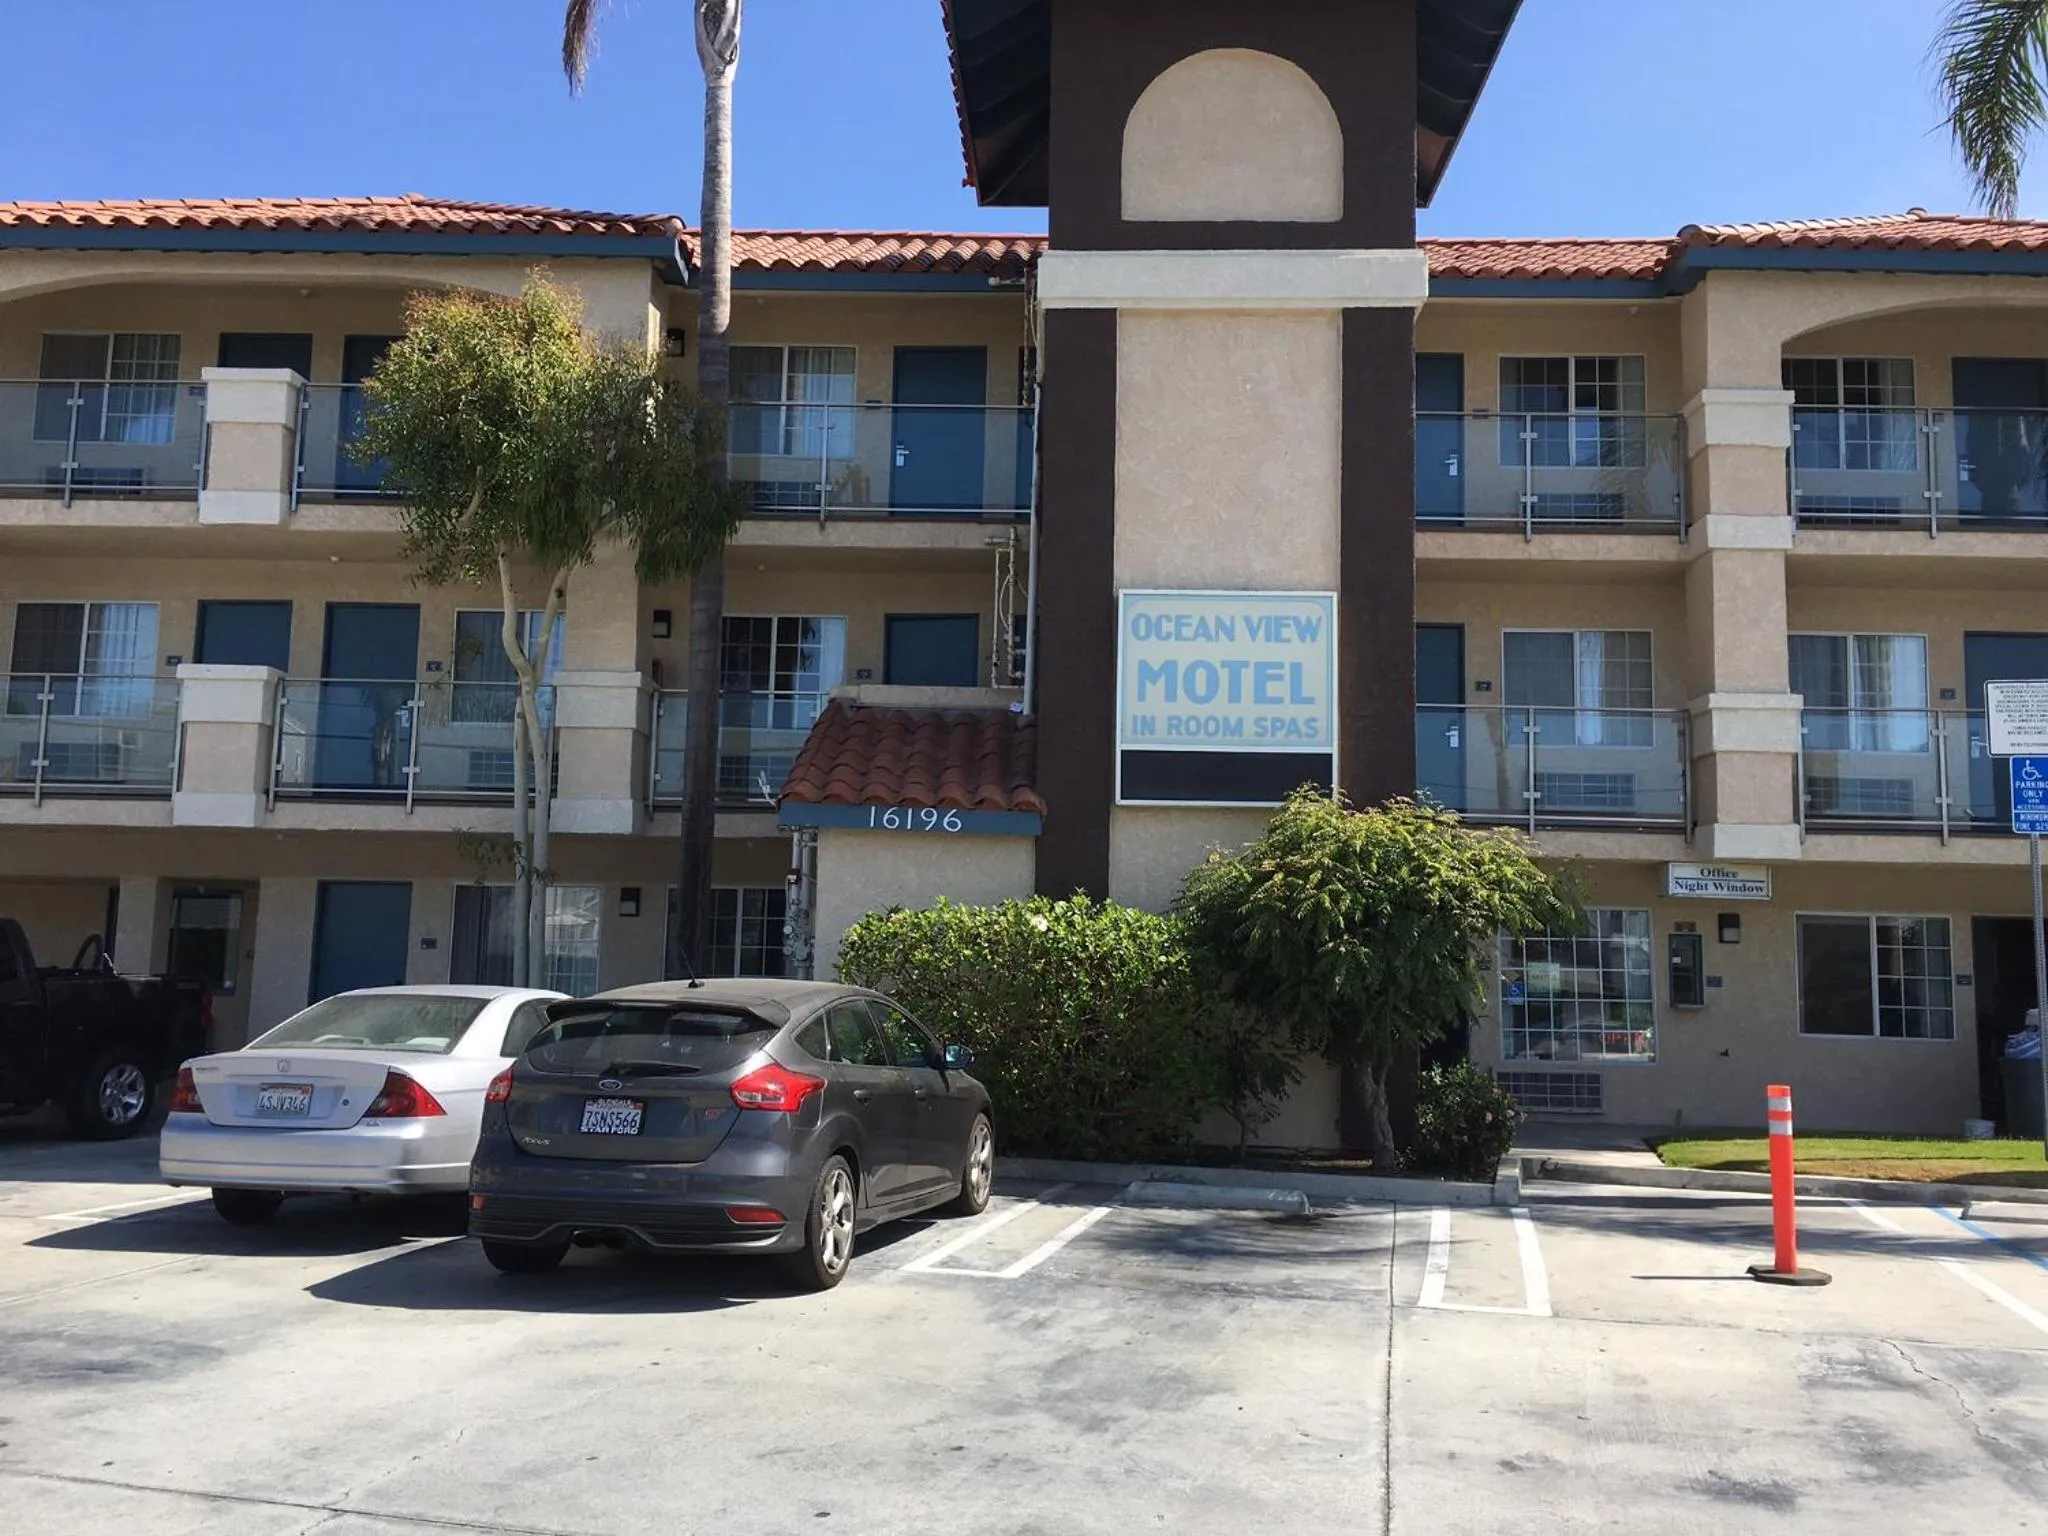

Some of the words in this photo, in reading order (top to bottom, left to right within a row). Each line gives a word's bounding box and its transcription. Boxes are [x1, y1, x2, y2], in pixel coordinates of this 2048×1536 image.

[1131, 613, 1235, 642] OCEAN
[1243, 615, 1323, 643] VIEW
[1137, 659, 1315, 705] MOTEL
[1132, 714, 1156, 736] IN
[1166, 715, 1243, 738] ROOM
[1253, 716, 1319, 738] SPAS
[2023, 790, 2043, 798] ONLY
[870, 805, 963, 832] 16196
[1700, 867, 1739, 879] Office
[1674, 880, 1708, 893] Night
[1714, 882, 1765, 893] Window
[586, 1110, 640, 1128] 7SNS566
